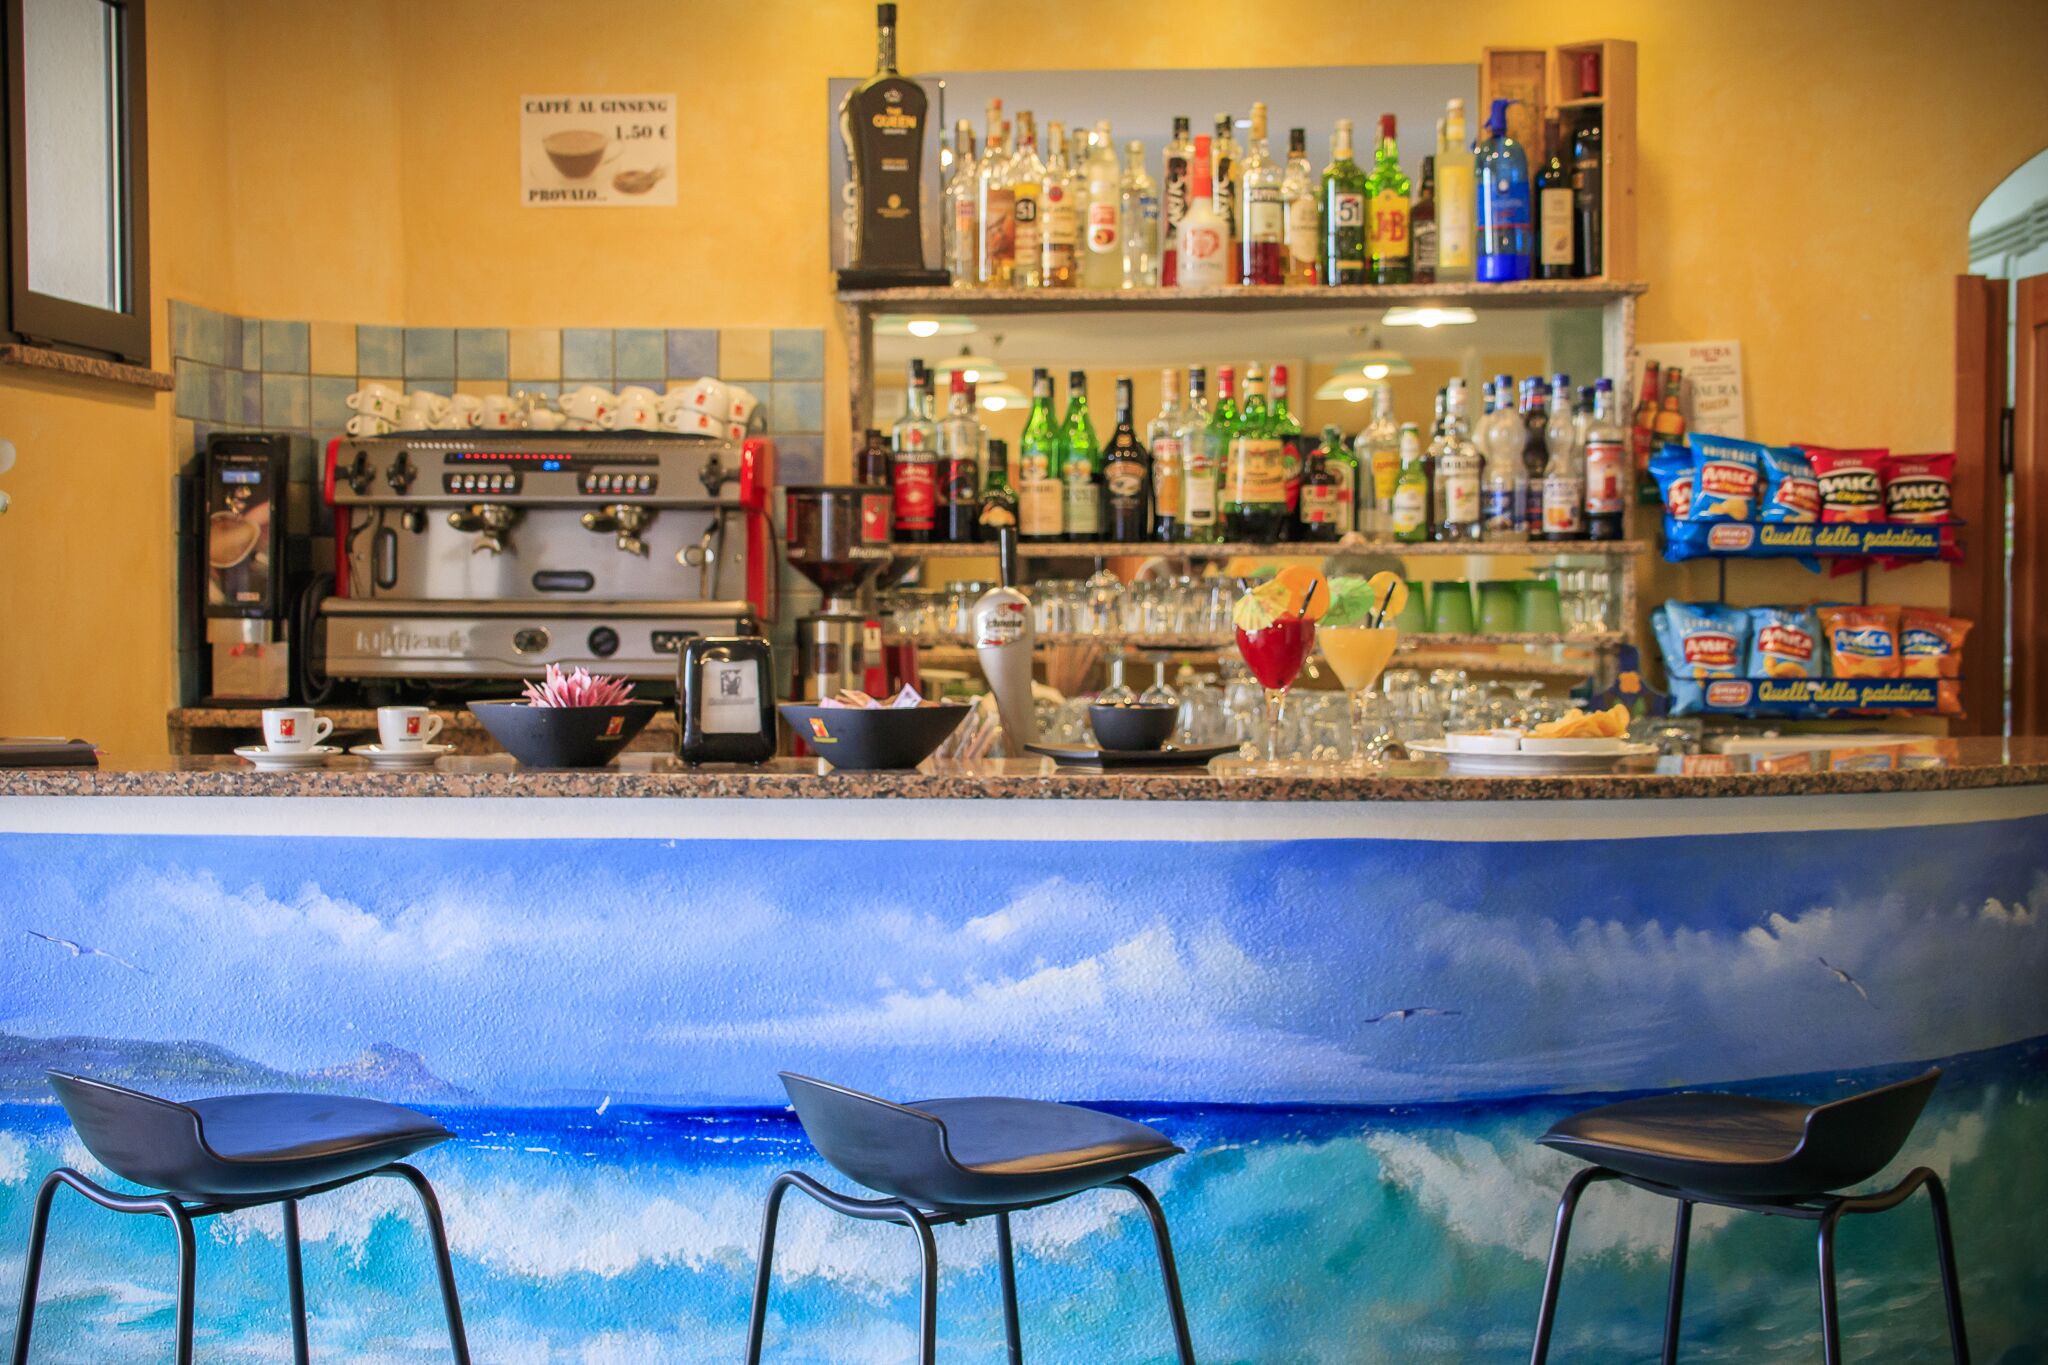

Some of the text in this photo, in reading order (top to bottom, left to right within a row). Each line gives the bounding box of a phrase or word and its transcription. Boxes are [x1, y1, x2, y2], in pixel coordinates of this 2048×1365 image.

[578, 101, 596, 113] AL
[601, 101, 667, 113] GINSENG
[872, 114, 917, 128] QUEEN
[616, 125, 668, 140] 1.50 €
[1339, 200, 1360, 221] 51
[1703, 467, 1757, 485] AMICA
[1819, 475, 1881, 495] AMICA
[1761, 525, 1813, 545] Quelli
[1816, 527, 1860, 545] della
[1759, 681, 1810, 701] Quelli
[1814, 682, 1858, 701] della
